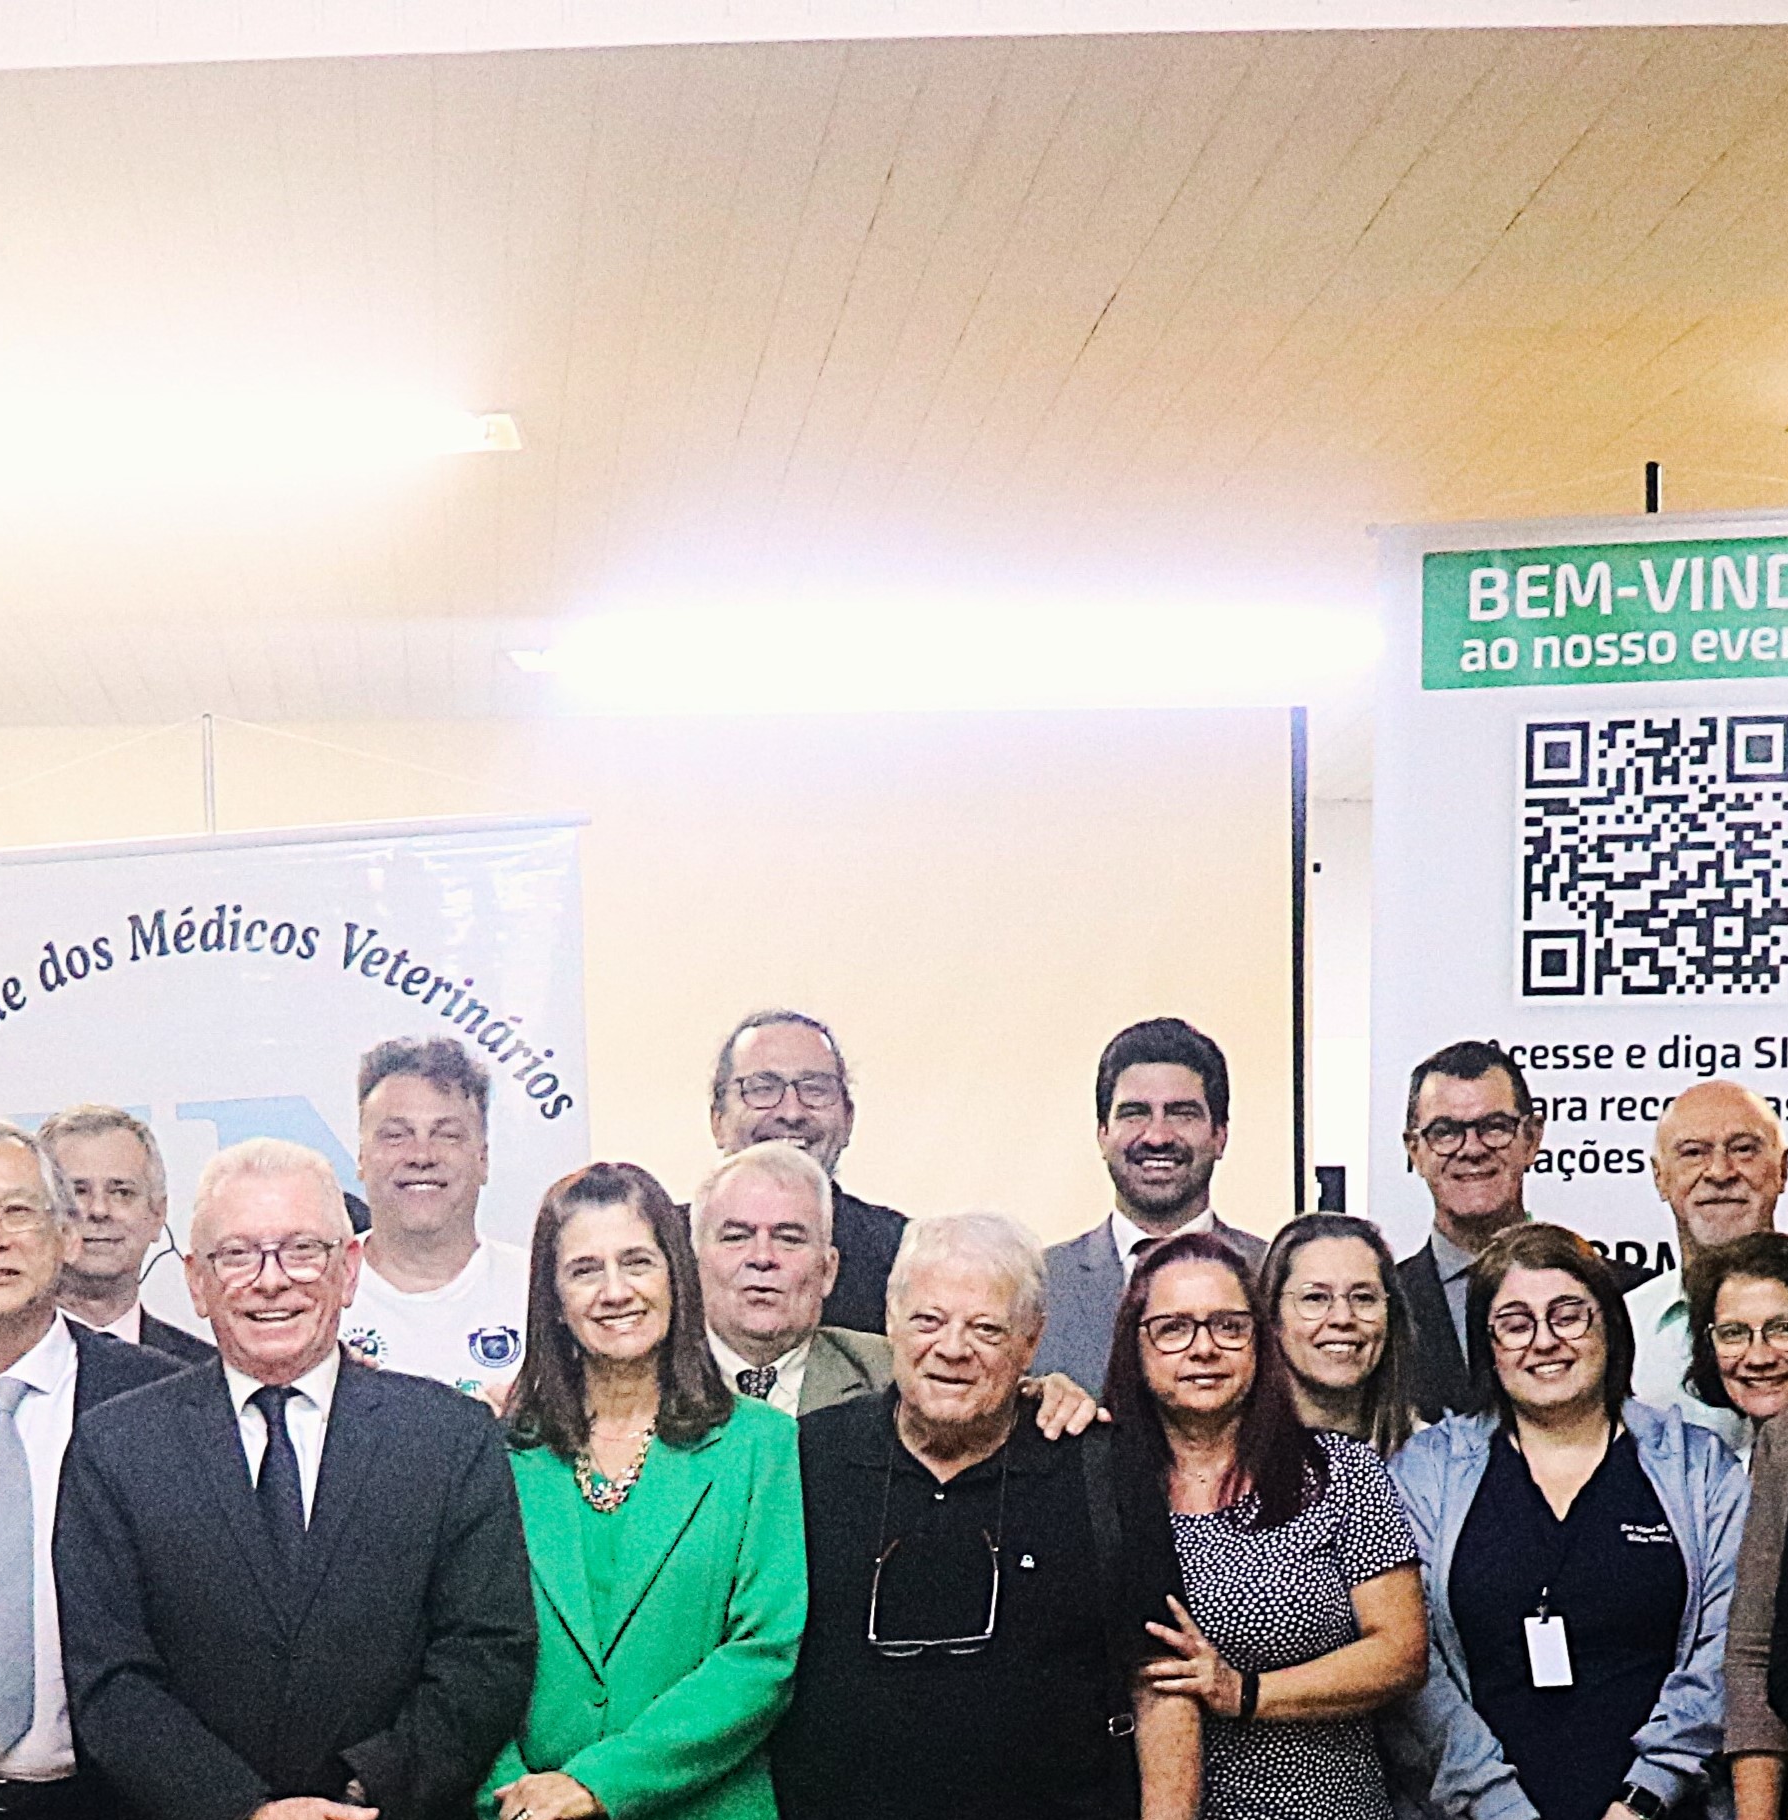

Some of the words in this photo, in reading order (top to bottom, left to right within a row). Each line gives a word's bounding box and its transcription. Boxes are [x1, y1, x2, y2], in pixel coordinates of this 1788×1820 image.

[1460, 636, 1518, 672] ao
[1533, 630, 1677, 670] nosso
[38, 937, 114, 993] dos
[128, 904, 320, 961] Médicos
[341, 922, 573, 1120] Veterinários
[1488, 1039, 1614, 1070] cesse
[1626, 1044, 1646, 1069] e
[1658, 1034, 1742, 1077] diga
[1531, 1096, 1587, 1121] ara
